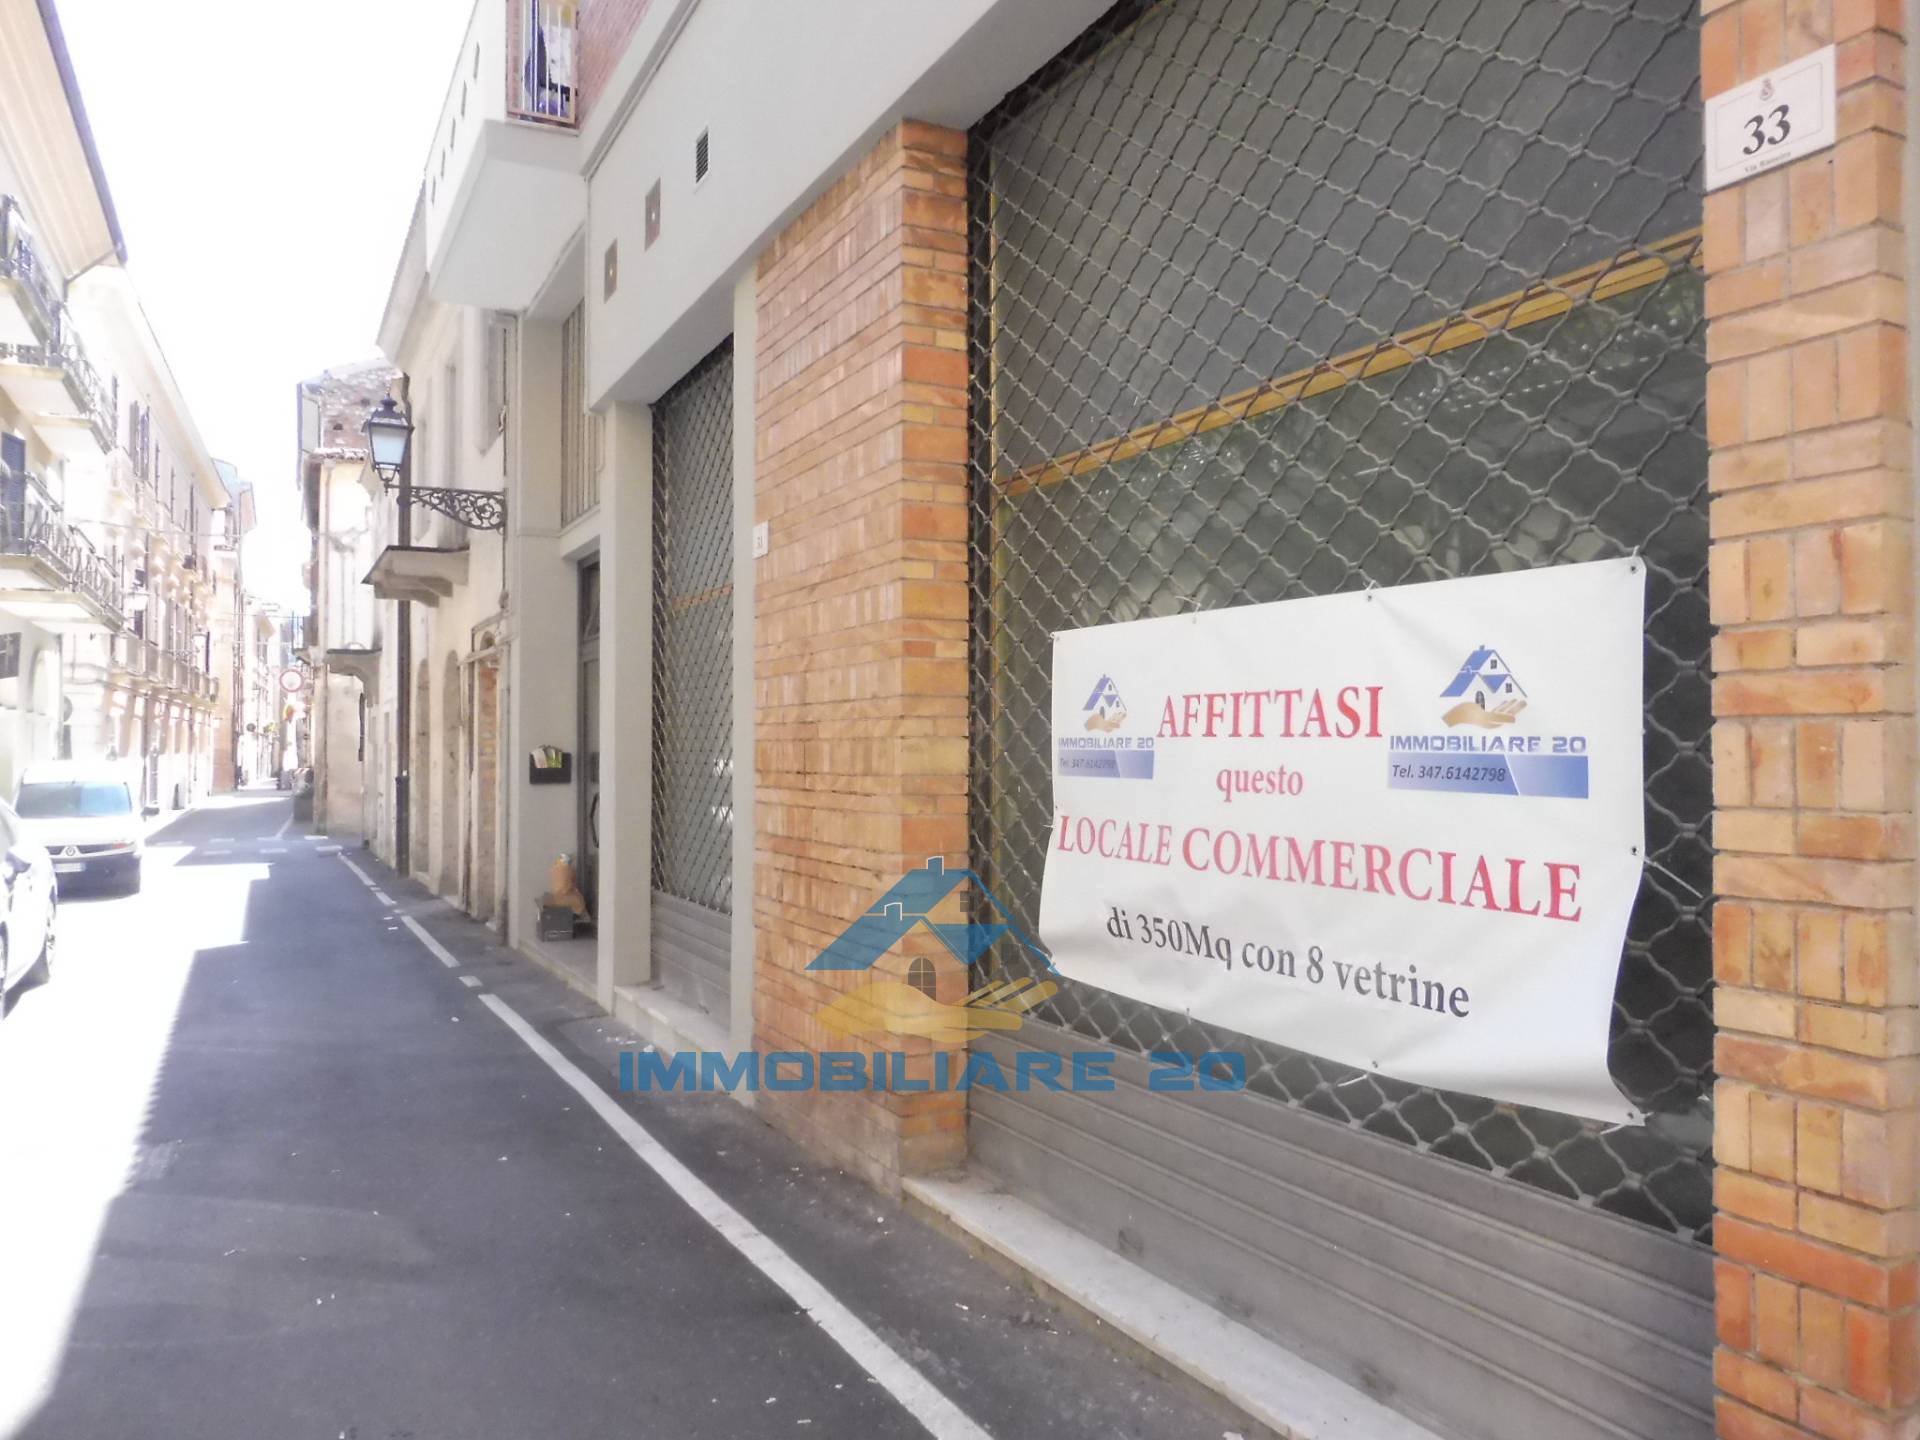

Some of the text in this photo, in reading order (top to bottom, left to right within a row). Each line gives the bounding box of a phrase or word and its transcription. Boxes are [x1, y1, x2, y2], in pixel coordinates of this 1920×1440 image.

[1742, 104, 1791, 155] 33
[1156, 686, 1383, 738] AFFITTASI
[1058, 736, 1154, 749] IMMOBILIARE 20
[1390, 735, 1586, 753] IMMOBILIARE 20
[1216, 764, 1304, 802] questo
[1393, 764, 1506, 783] Tel. 347.6142798
[1057, 815, 1582, 922] LOCALE COMMERCIALE
[1107, 906, 1470, 1018] di 350Mq con 8 vetrine
